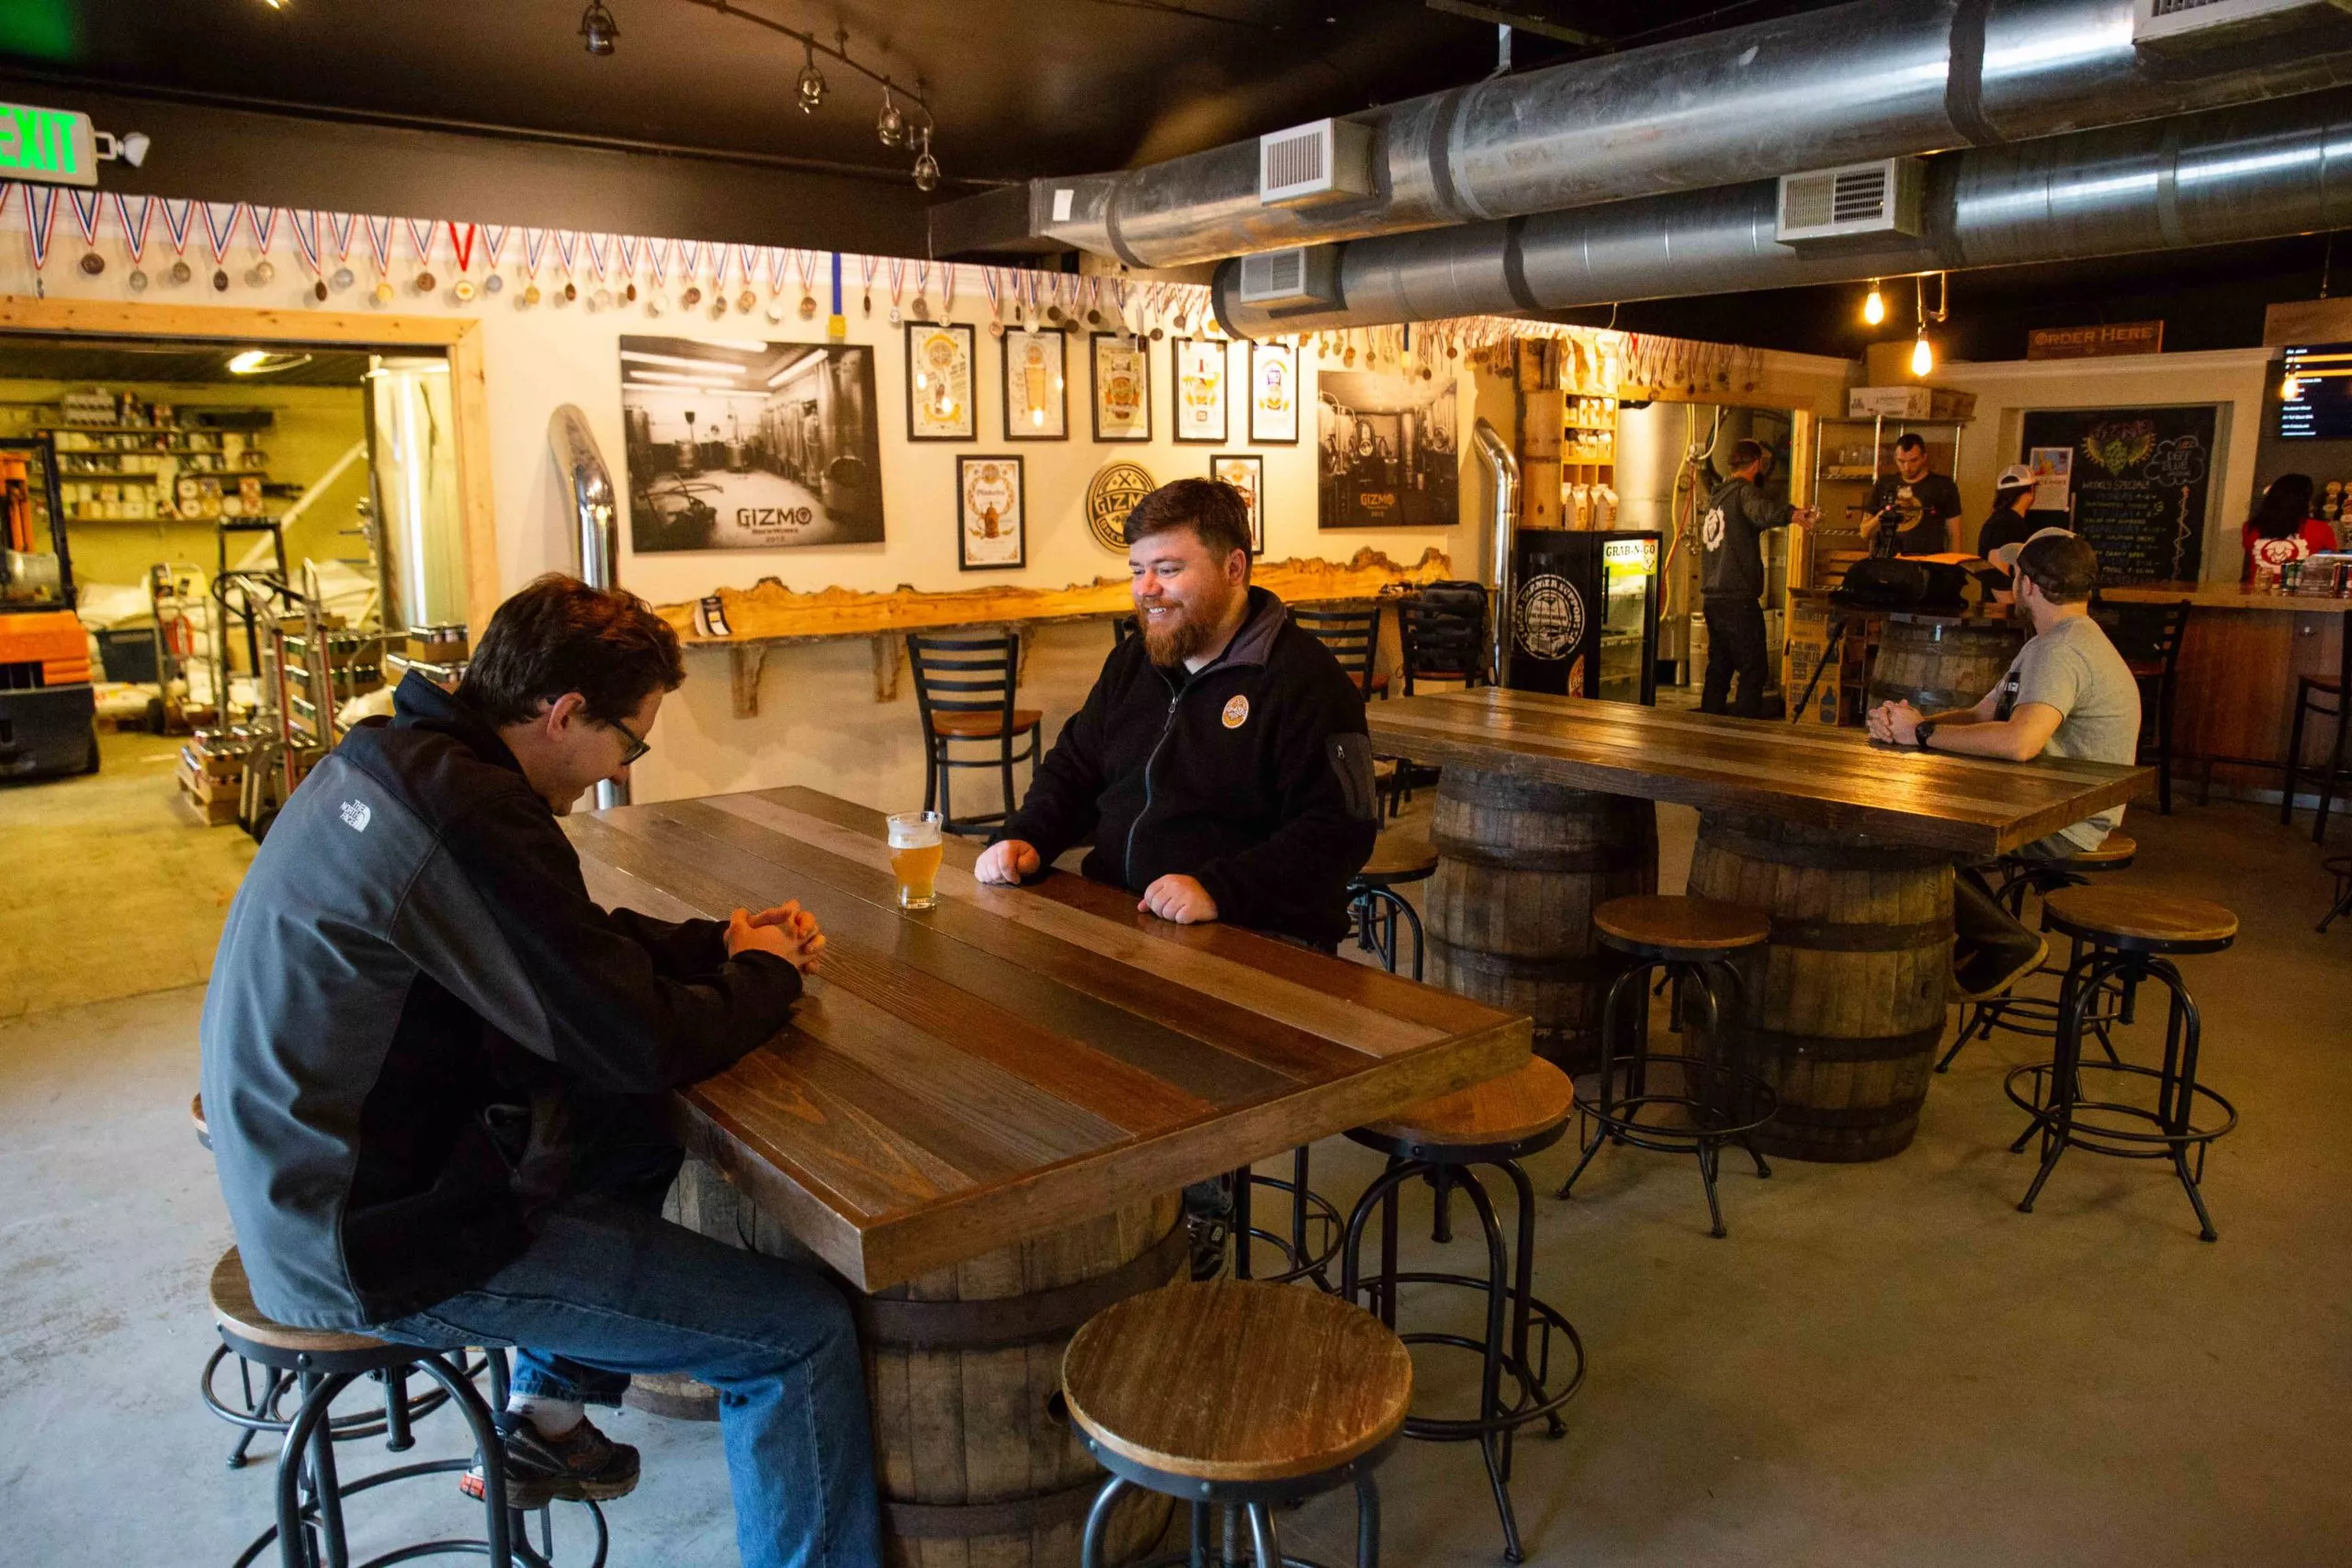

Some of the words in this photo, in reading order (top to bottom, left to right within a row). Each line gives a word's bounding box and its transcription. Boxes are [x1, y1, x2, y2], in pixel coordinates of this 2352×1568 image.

[0, 106, 77, 174] EXIT
[2035, 332, 2096, 345] ORDER
[2100, 327, 2154, 343] HERE
[1094, 492, 1145, 514] GIZM
[1360, 492, 1395, 507] GIZMO
[736, 507, 812, 528] GIZMO
[340, 801, 361, 818] NORTH
[353, 798, 367, 812] THE
[339, 812, 358, 826] FACE
